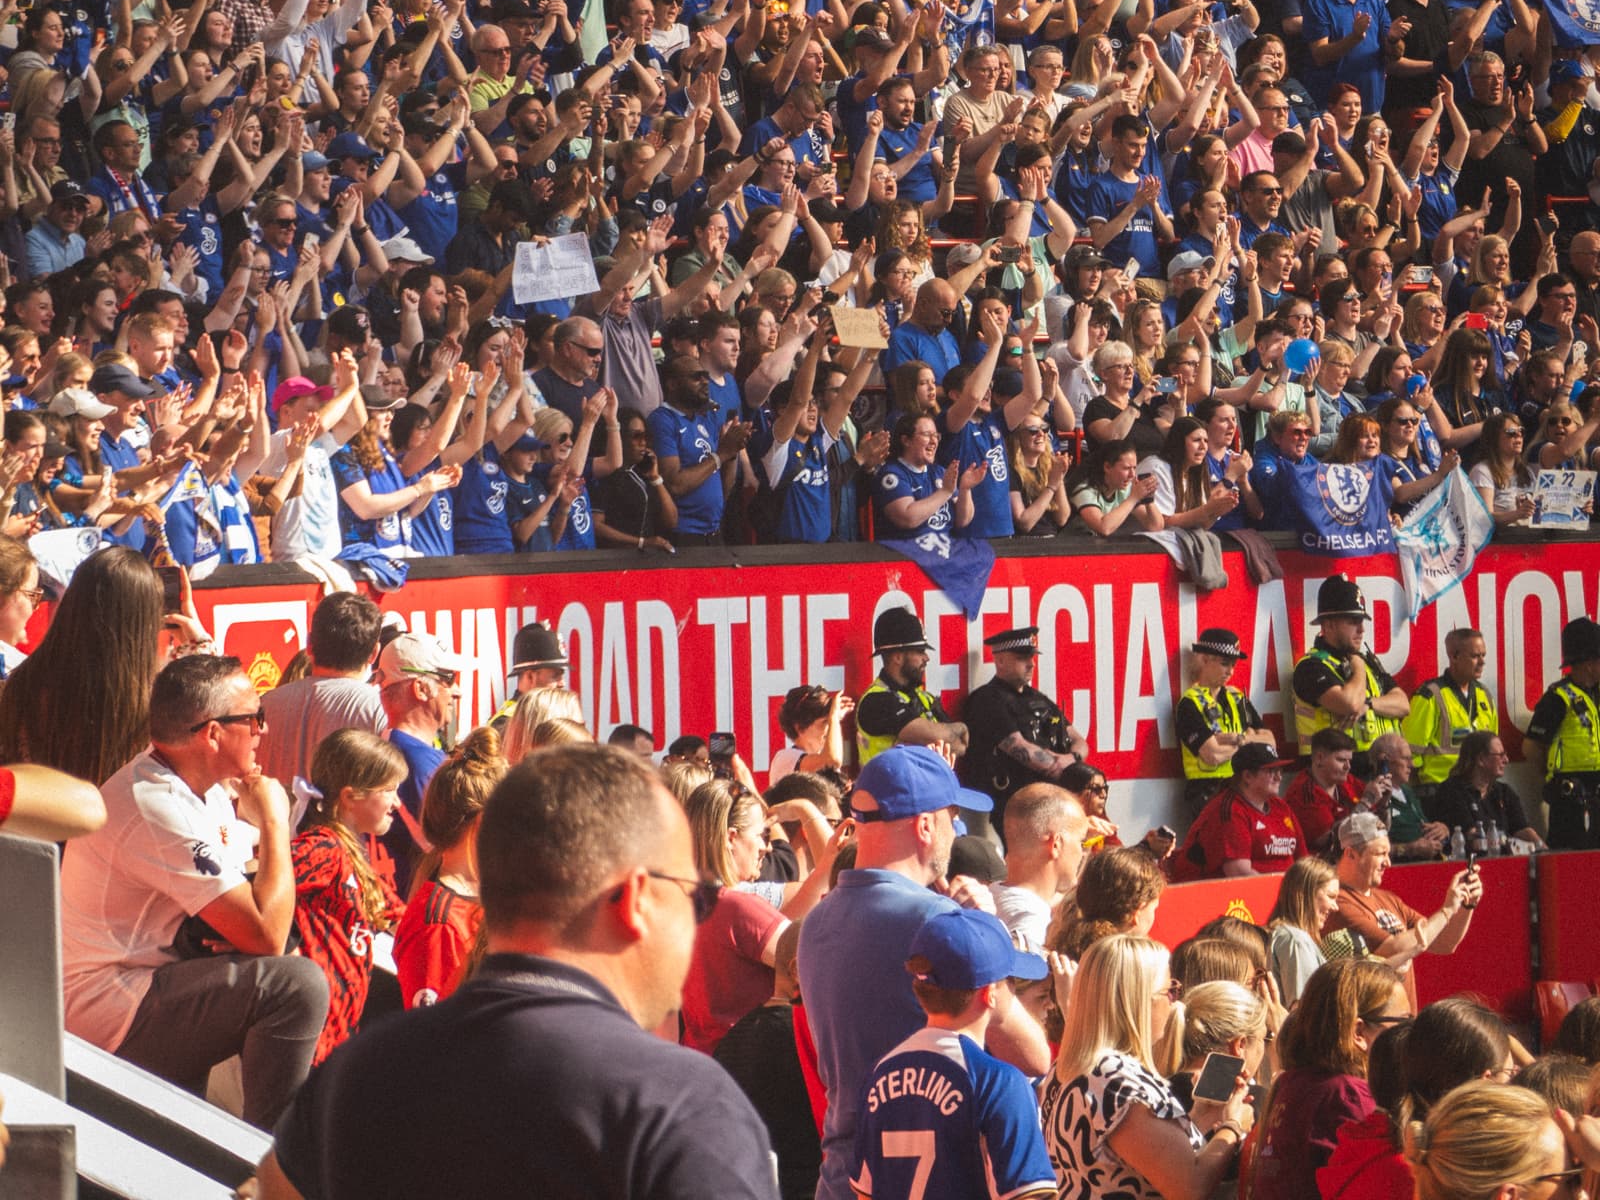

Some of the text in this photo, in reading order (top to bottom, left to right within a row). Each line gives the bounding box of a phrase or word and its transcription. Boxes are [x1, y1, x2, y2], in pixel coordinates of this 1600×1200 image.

[1302, 528, 1390, 550] CHELSEA FC
[381, 570, 1600, 772] WNOAD THE FFCIA AP NO
[867, 1066, 965, 1117] STERLING
[881, 1129, 936, 1200] 7
